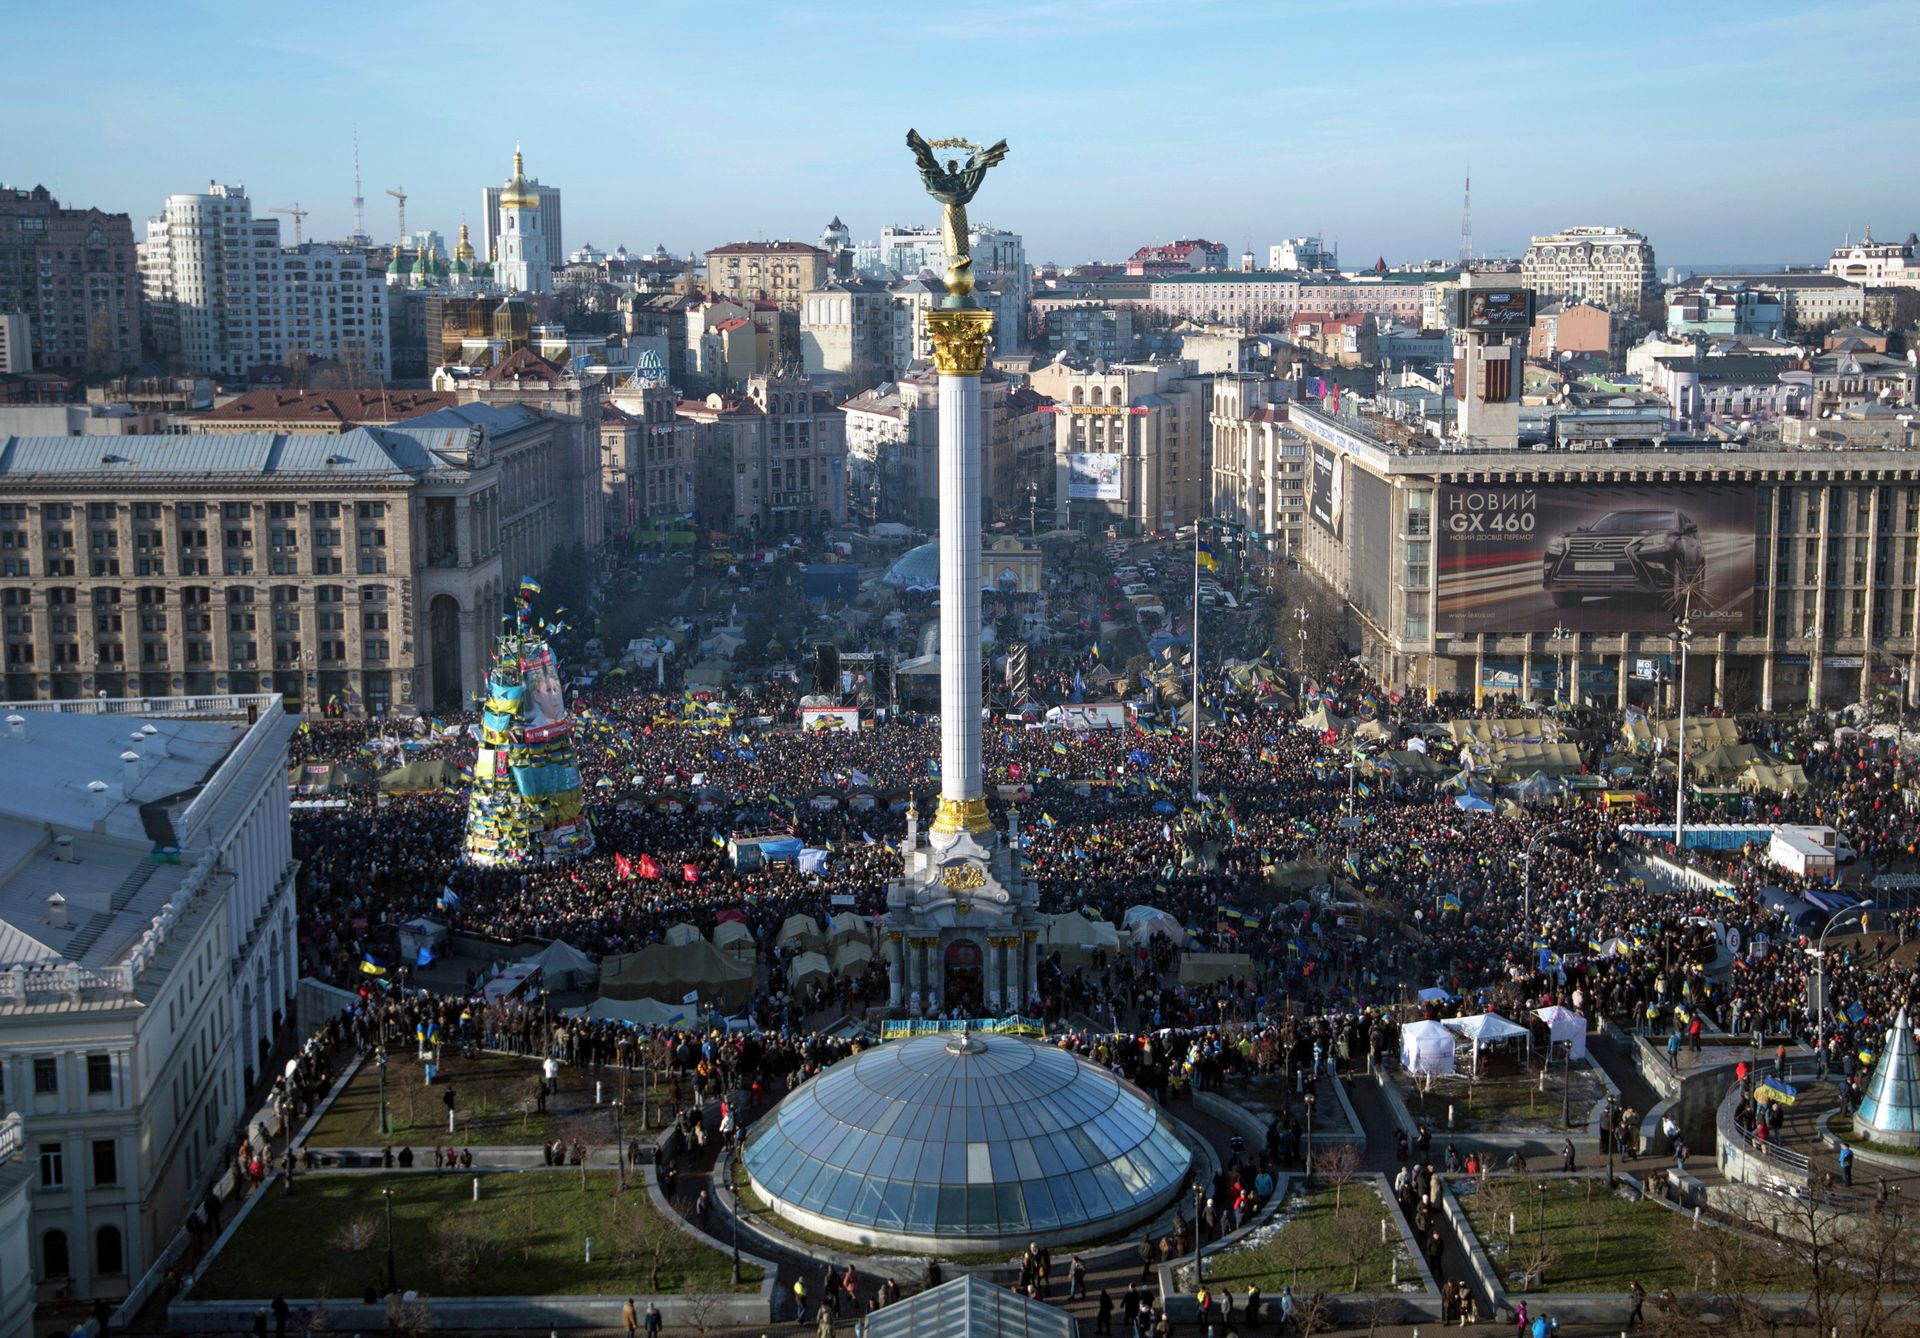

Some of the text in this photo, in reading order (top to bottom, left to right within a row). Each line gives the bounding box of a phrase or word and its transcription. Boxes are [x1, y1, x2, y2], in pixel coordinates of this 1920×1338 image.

[1449, 489, 1536, 511] НОВИЙ
[1449, 512, 1535, 532] GX 460
[1450, 533, 1475, 541] НОВИЙ
